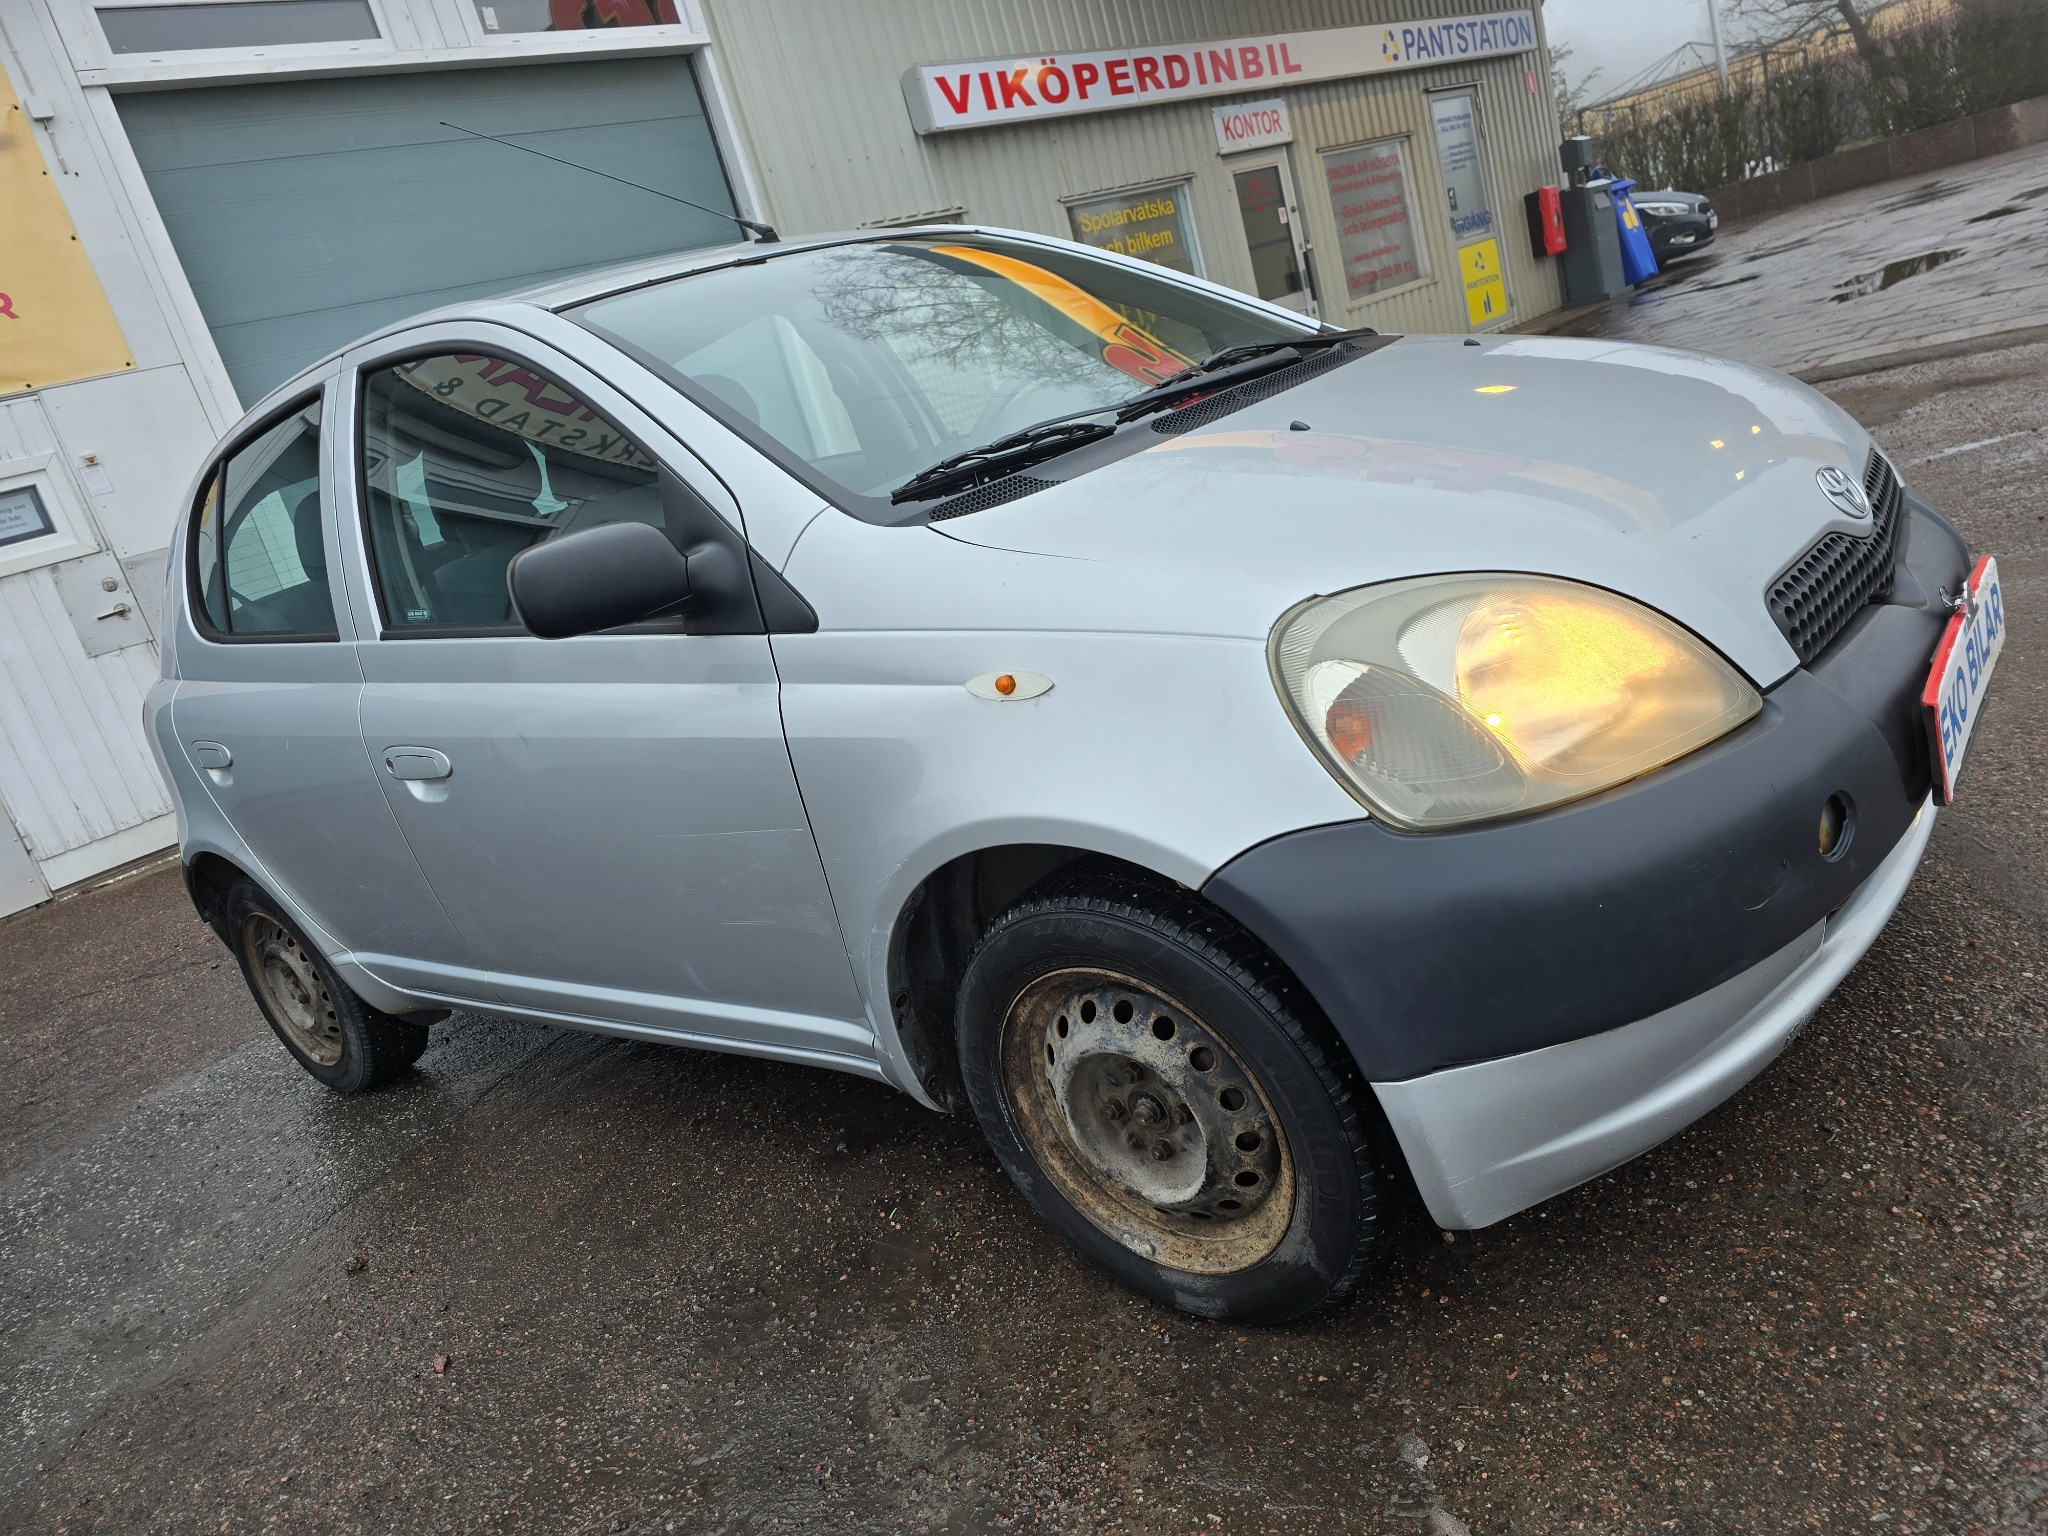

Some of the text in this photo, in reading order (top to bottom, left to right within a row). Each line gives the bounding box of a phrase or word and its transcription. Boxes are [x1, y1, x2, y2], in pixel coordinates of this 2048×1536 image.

[1402, 15, 1532, 61] PANTSTATION
[1222, 109, 1284, 141] KONTOR
[1080, 198, 1175, 235] Spolarvätska
[1100, 230, 1174, 254] ch bilkem
[1466, 273, 1499, 290] PANTSTATION
[1940, 583, 2003, 770] EKO BILAR
